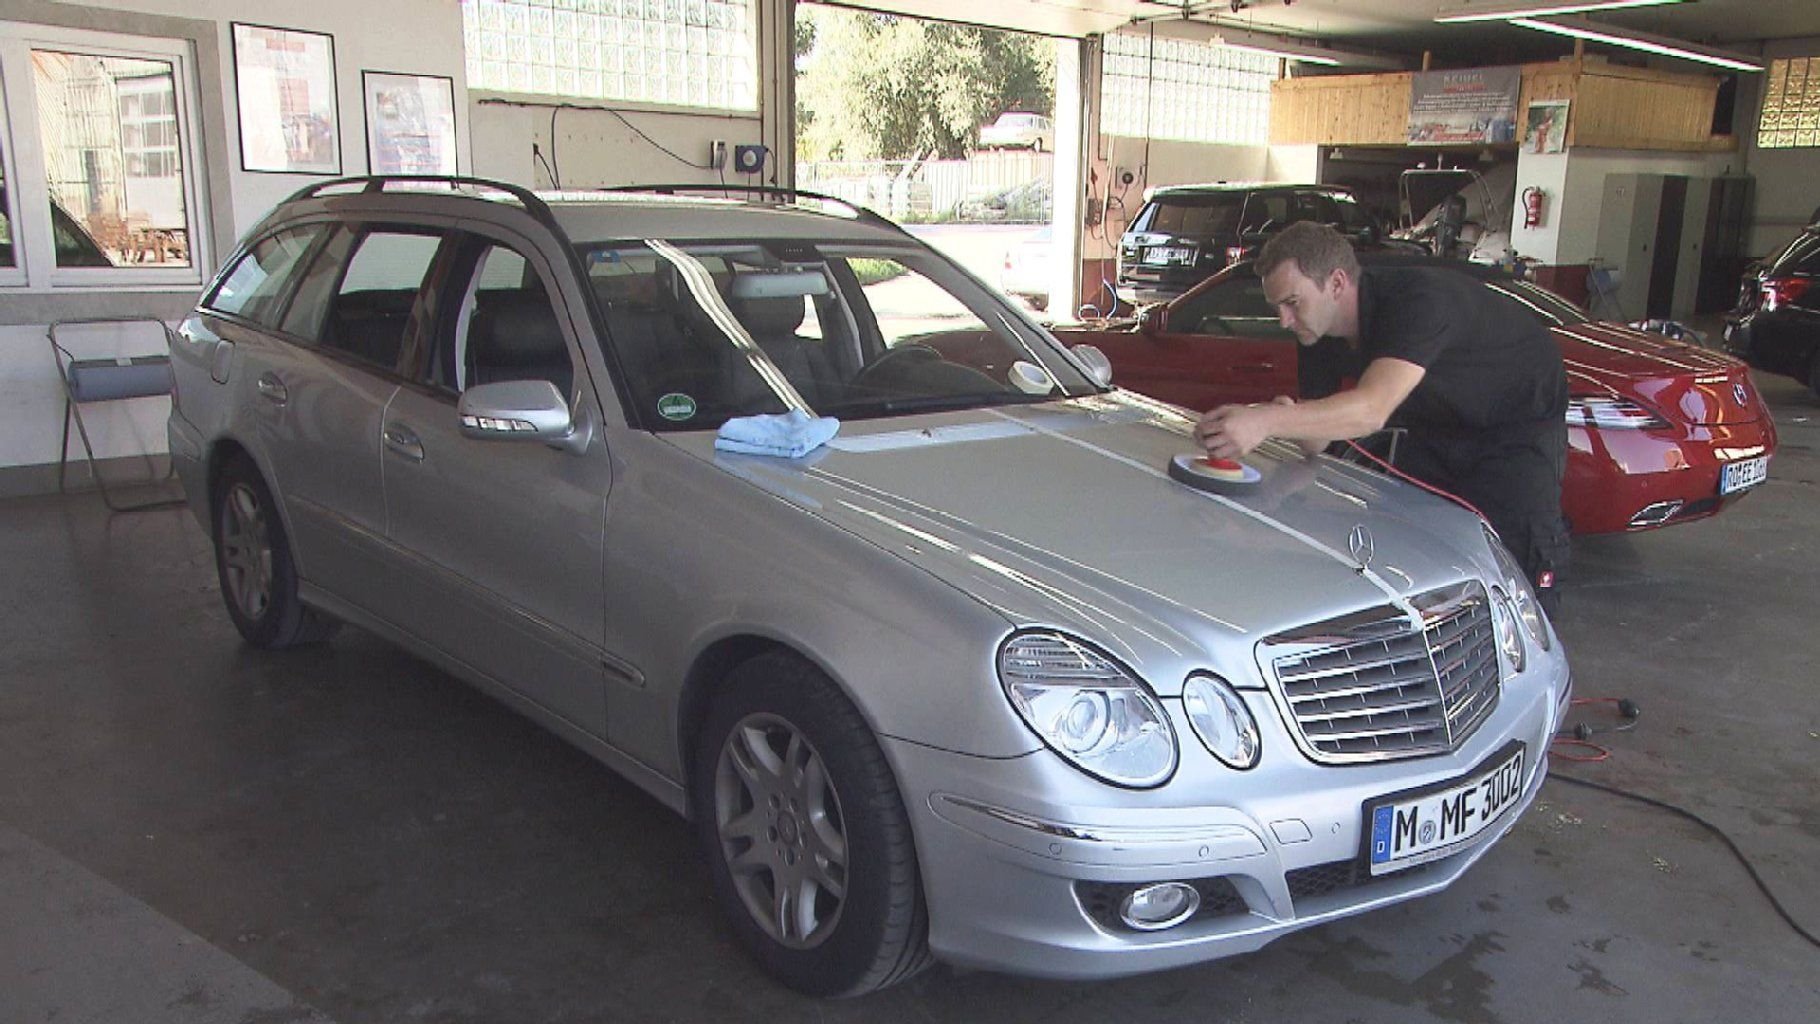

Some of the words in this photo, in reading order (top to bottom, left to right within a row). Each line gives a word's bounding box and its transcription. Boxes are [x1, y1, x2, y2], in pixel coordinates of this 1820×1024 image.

[1394, 805, 1418, 853] M
[1440, 787, 1477, 840] MF
[1481, 754, 1521, 821] 3002
[1377, 841, 1385, 853] D
